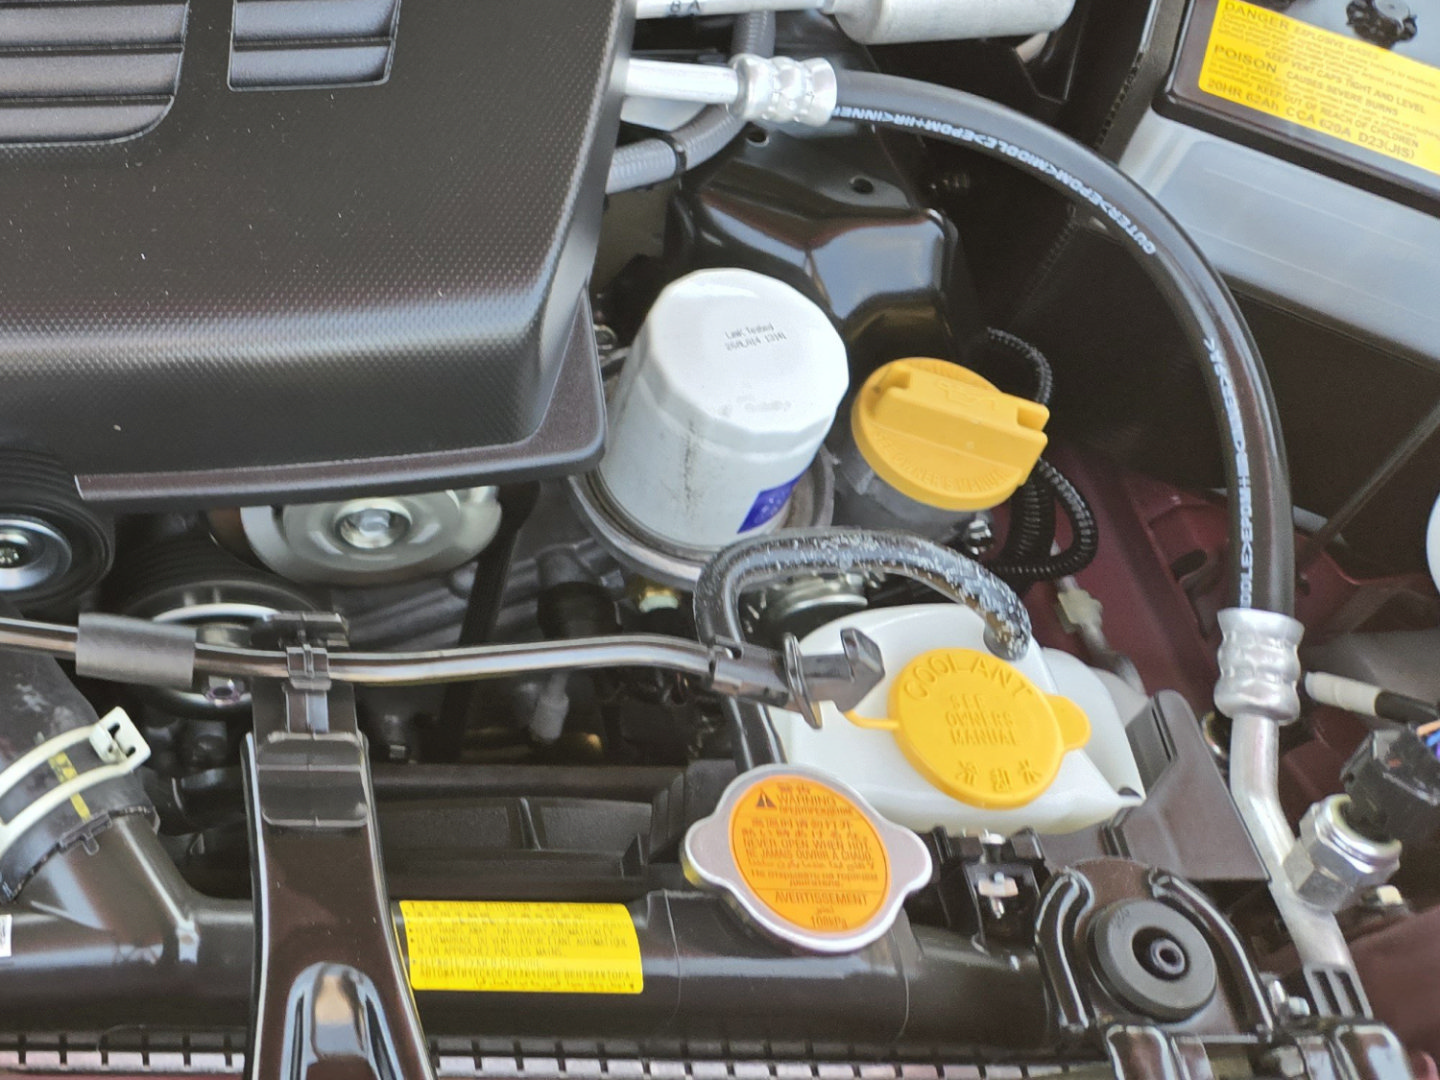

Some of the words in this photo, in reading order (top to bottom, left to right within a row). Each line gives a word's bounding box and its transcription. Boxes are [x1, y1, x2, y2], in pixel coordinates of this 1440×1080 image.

[1225, 1, 1289, 30] DANGER
[1214, 44, 1278, 73] POISON
[1316, 70, 1342, 83] CAPS
[1396, 97, 1426, 114] LEVEL
[1283, 94, 1302, 106] OUT
[1370, 124, 1419, 148] CHILDREN
[1286, 106, 1317, 125] CCA
[903, 653, 1033, 700] COOLANT
[949, 728, 1017, 746] MANUAL
[781, 838, 809, 849] OPEN
[813, 839, 844, 850] WHEN
[776, 891, 868, 905] AVERTISSEMENT
